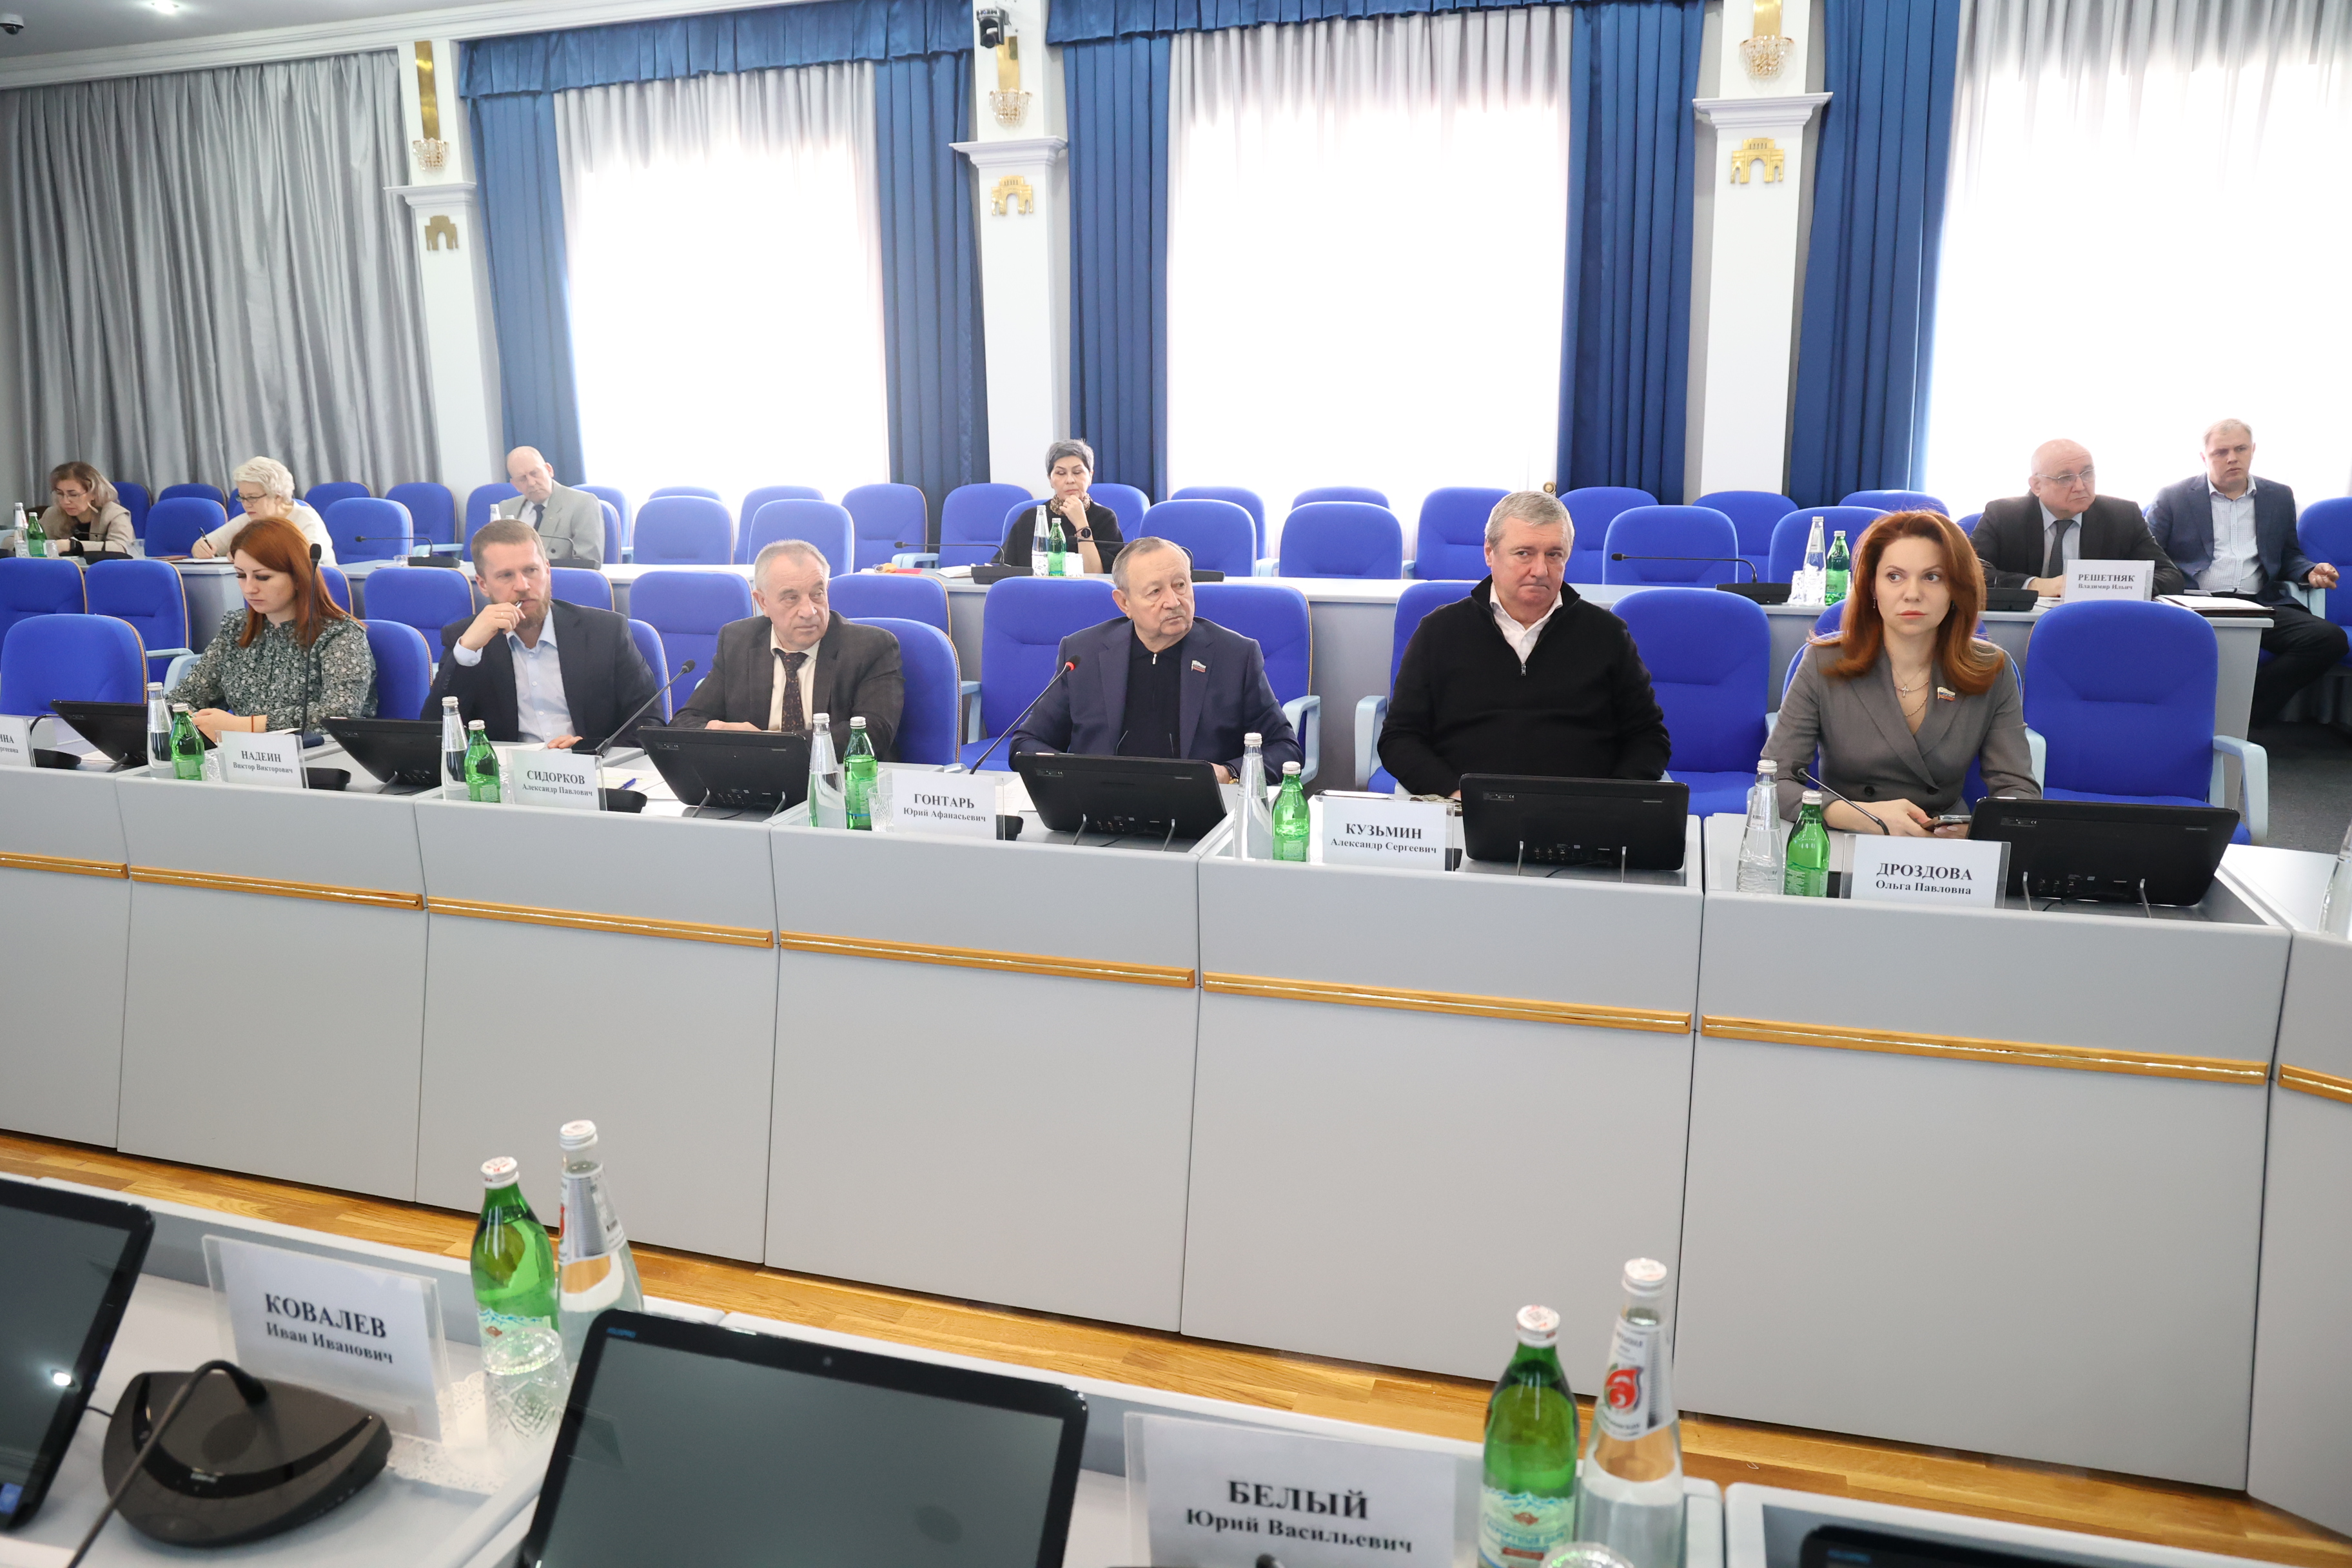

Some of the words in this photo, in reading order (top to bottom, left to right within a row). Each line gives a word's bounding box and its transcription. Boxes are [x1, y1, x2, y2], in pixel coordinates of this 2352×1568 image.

[241, 750, 282, 762] НАДЕИН
[233, 761, 255, 772] Виктор
[256, 764, 293, 774] Викторович
[527, 770, 585, 785] СИДОРКОВ
[522, 783, 558, 794] Александр
[558, 786, 593, 796] Павлович
[914, 794, 975, 808] ГОНТАРЬ
[903, 807, 928, 817] Юрий
[930, 810, 986, 822] Афанасьевич
[1346, 823, 1422, 839] КУЗЬМИН
[1330, 838, 1383, 851] Александр
[1386, 842, 1437, 854] Сергеевич
[1876, 863, 1973, 881] ДРОЗДОВА
[1876, 879, 1911, 891] Ольга
[1915, 882, 1972, 895] Павловна
[265, 1293, 386, 1338] КОВАЛЕВ
[266, 1321, 308, 1344] Иван
[312, 1331, 393, 1364] Иванович
[1227, 1480, 1368, 1520] БЕЛЫЙ
[1186, 1508, 1259, 1533] Юрий
[1268, 1519, 1413, 1553] Васильевич
